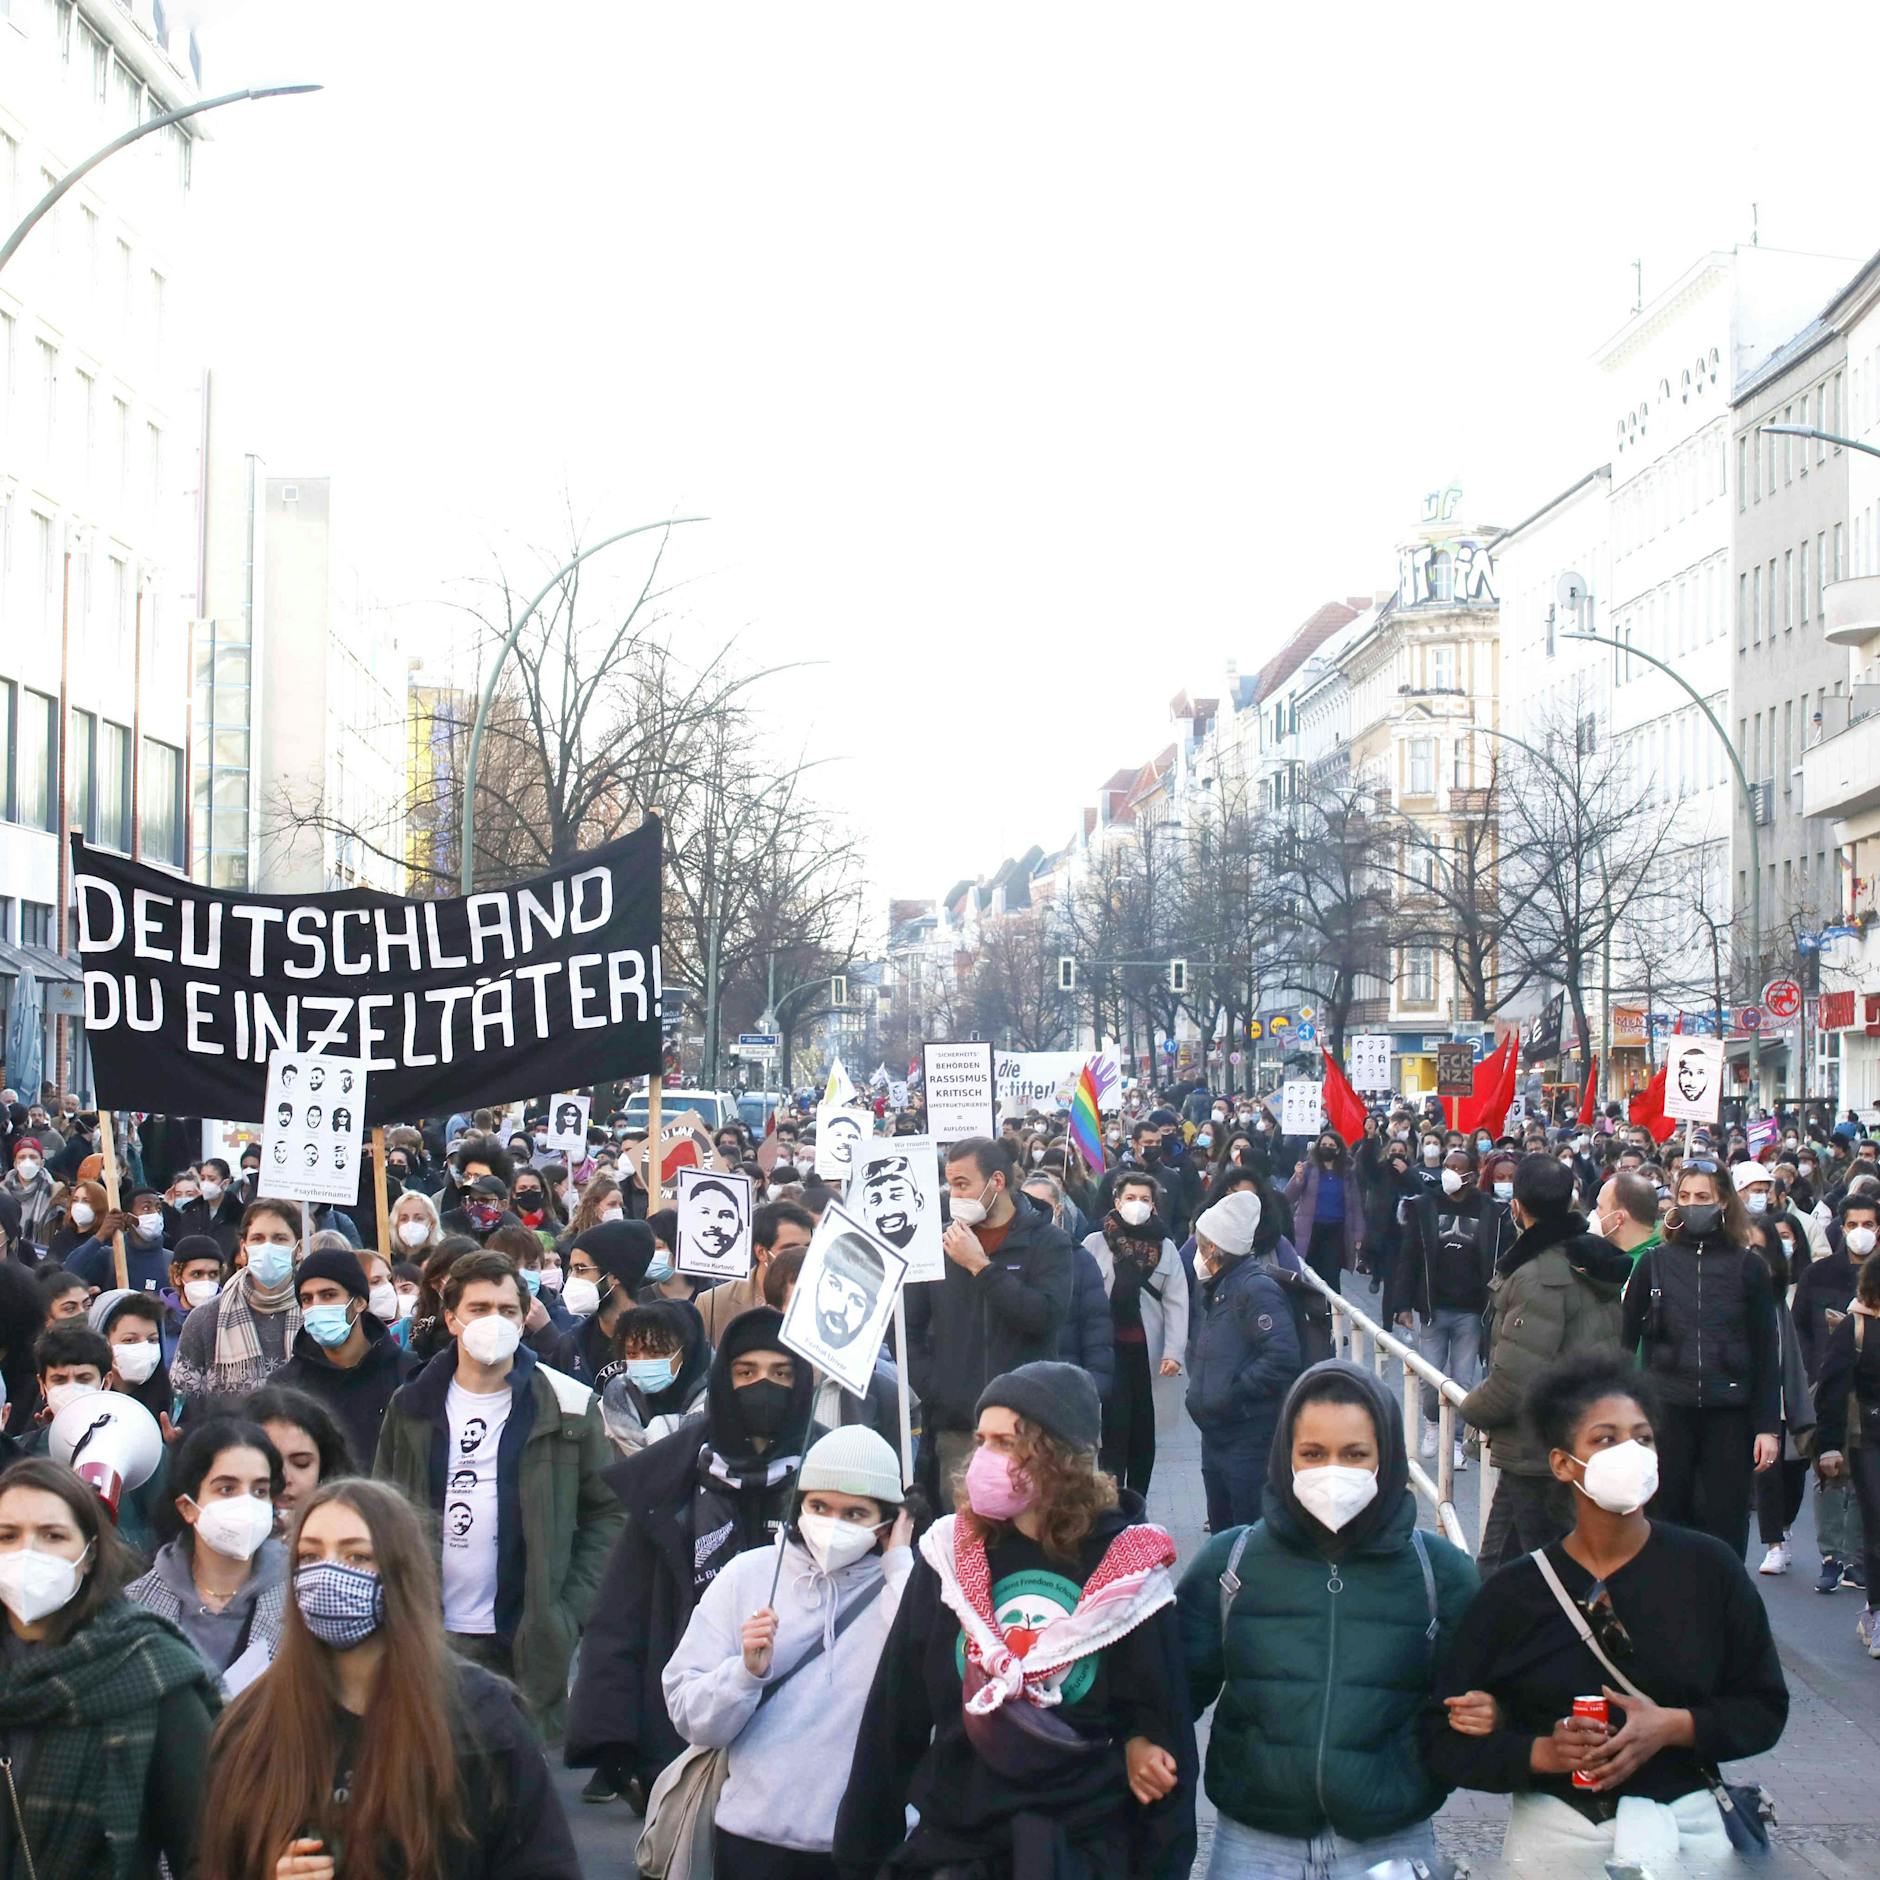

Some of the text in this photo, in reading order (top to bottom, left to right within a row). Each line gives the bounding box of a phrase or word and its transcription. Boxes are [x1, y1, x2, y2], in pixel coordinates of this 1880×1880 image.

[76, 866, 613, 978] DEUTSCHLAND
[84, 945, 662, 1070] DU EINZELTÄTER!
[1440, 1054, 1471, 1068] FCK
[998, 1059, 1020, 1078] die
[930, 1074, 988, 1083] RASSISMUS
[1440, 1069, 1471, 1082] NZS
[936, 1089, 982, 1097] KRITISCH
[294, 1187, 352, 1199] #saytheirnames
[1020, 1578, 1054, 1588] Freedom
